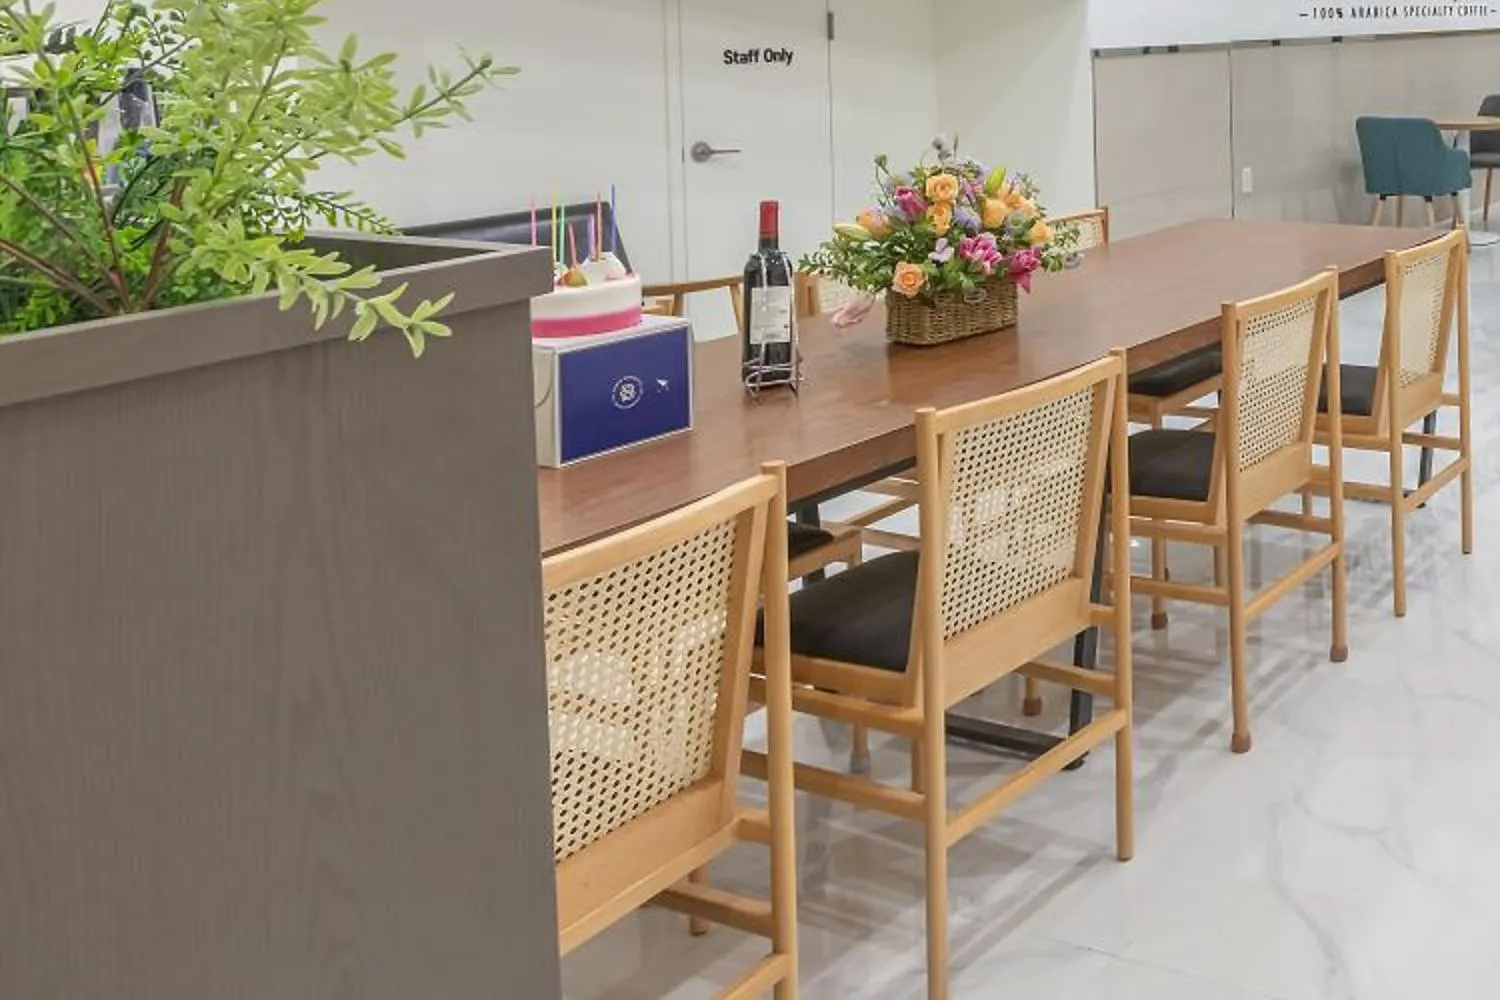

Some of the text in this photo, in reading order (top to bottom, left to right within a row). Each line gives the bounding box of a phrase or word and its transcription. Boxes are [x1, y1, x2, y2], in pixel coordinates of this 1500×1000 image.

[1313, 5, 1488, 20] 100% ARABICA SPECIALTY COFFEE
[723, 48, 793, 66] Staff Only
